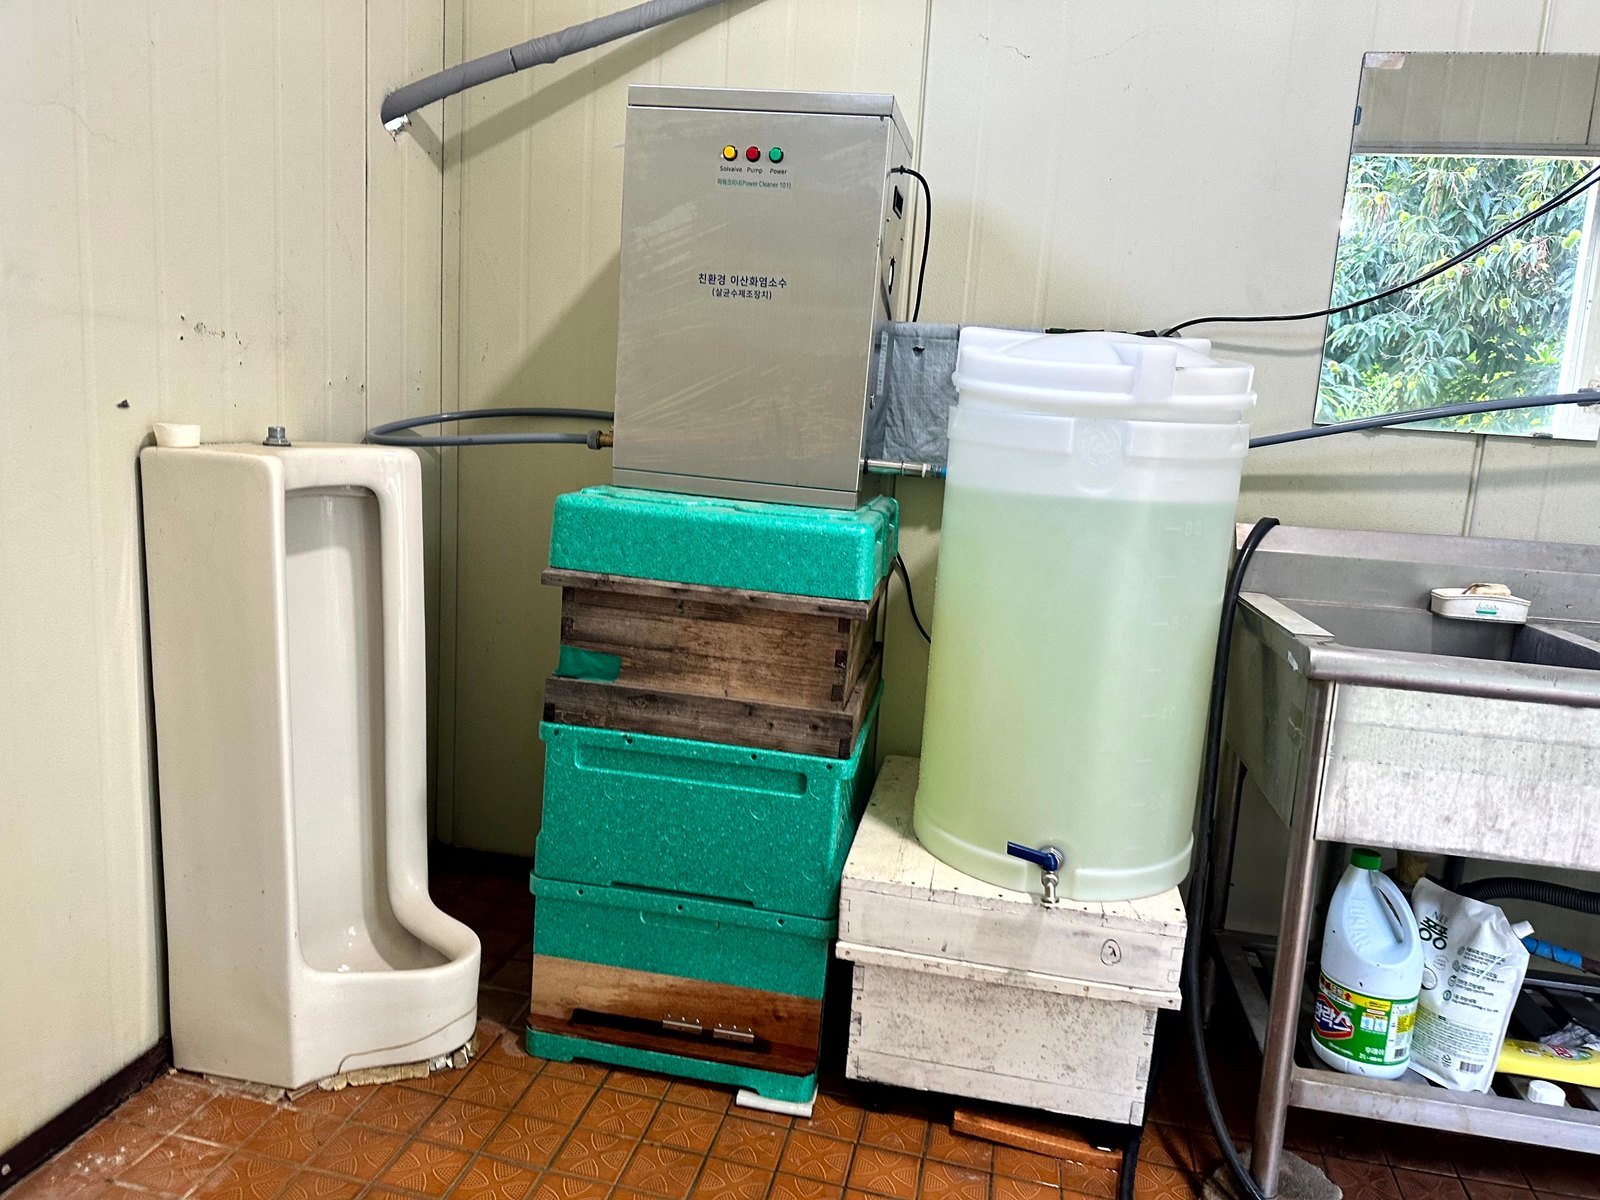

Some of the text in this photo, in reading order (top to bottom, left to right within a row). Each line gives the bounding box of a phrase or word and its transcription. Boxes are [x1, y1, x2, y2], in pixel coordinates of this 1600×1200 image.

[746, 166, 764, 174] Pump
[758, 179, 779, 188] Cleaner
[698, 272, 788, 289] 친환경 이산화염소수
[711, 287, 773, 300] (살균수제조장치)
